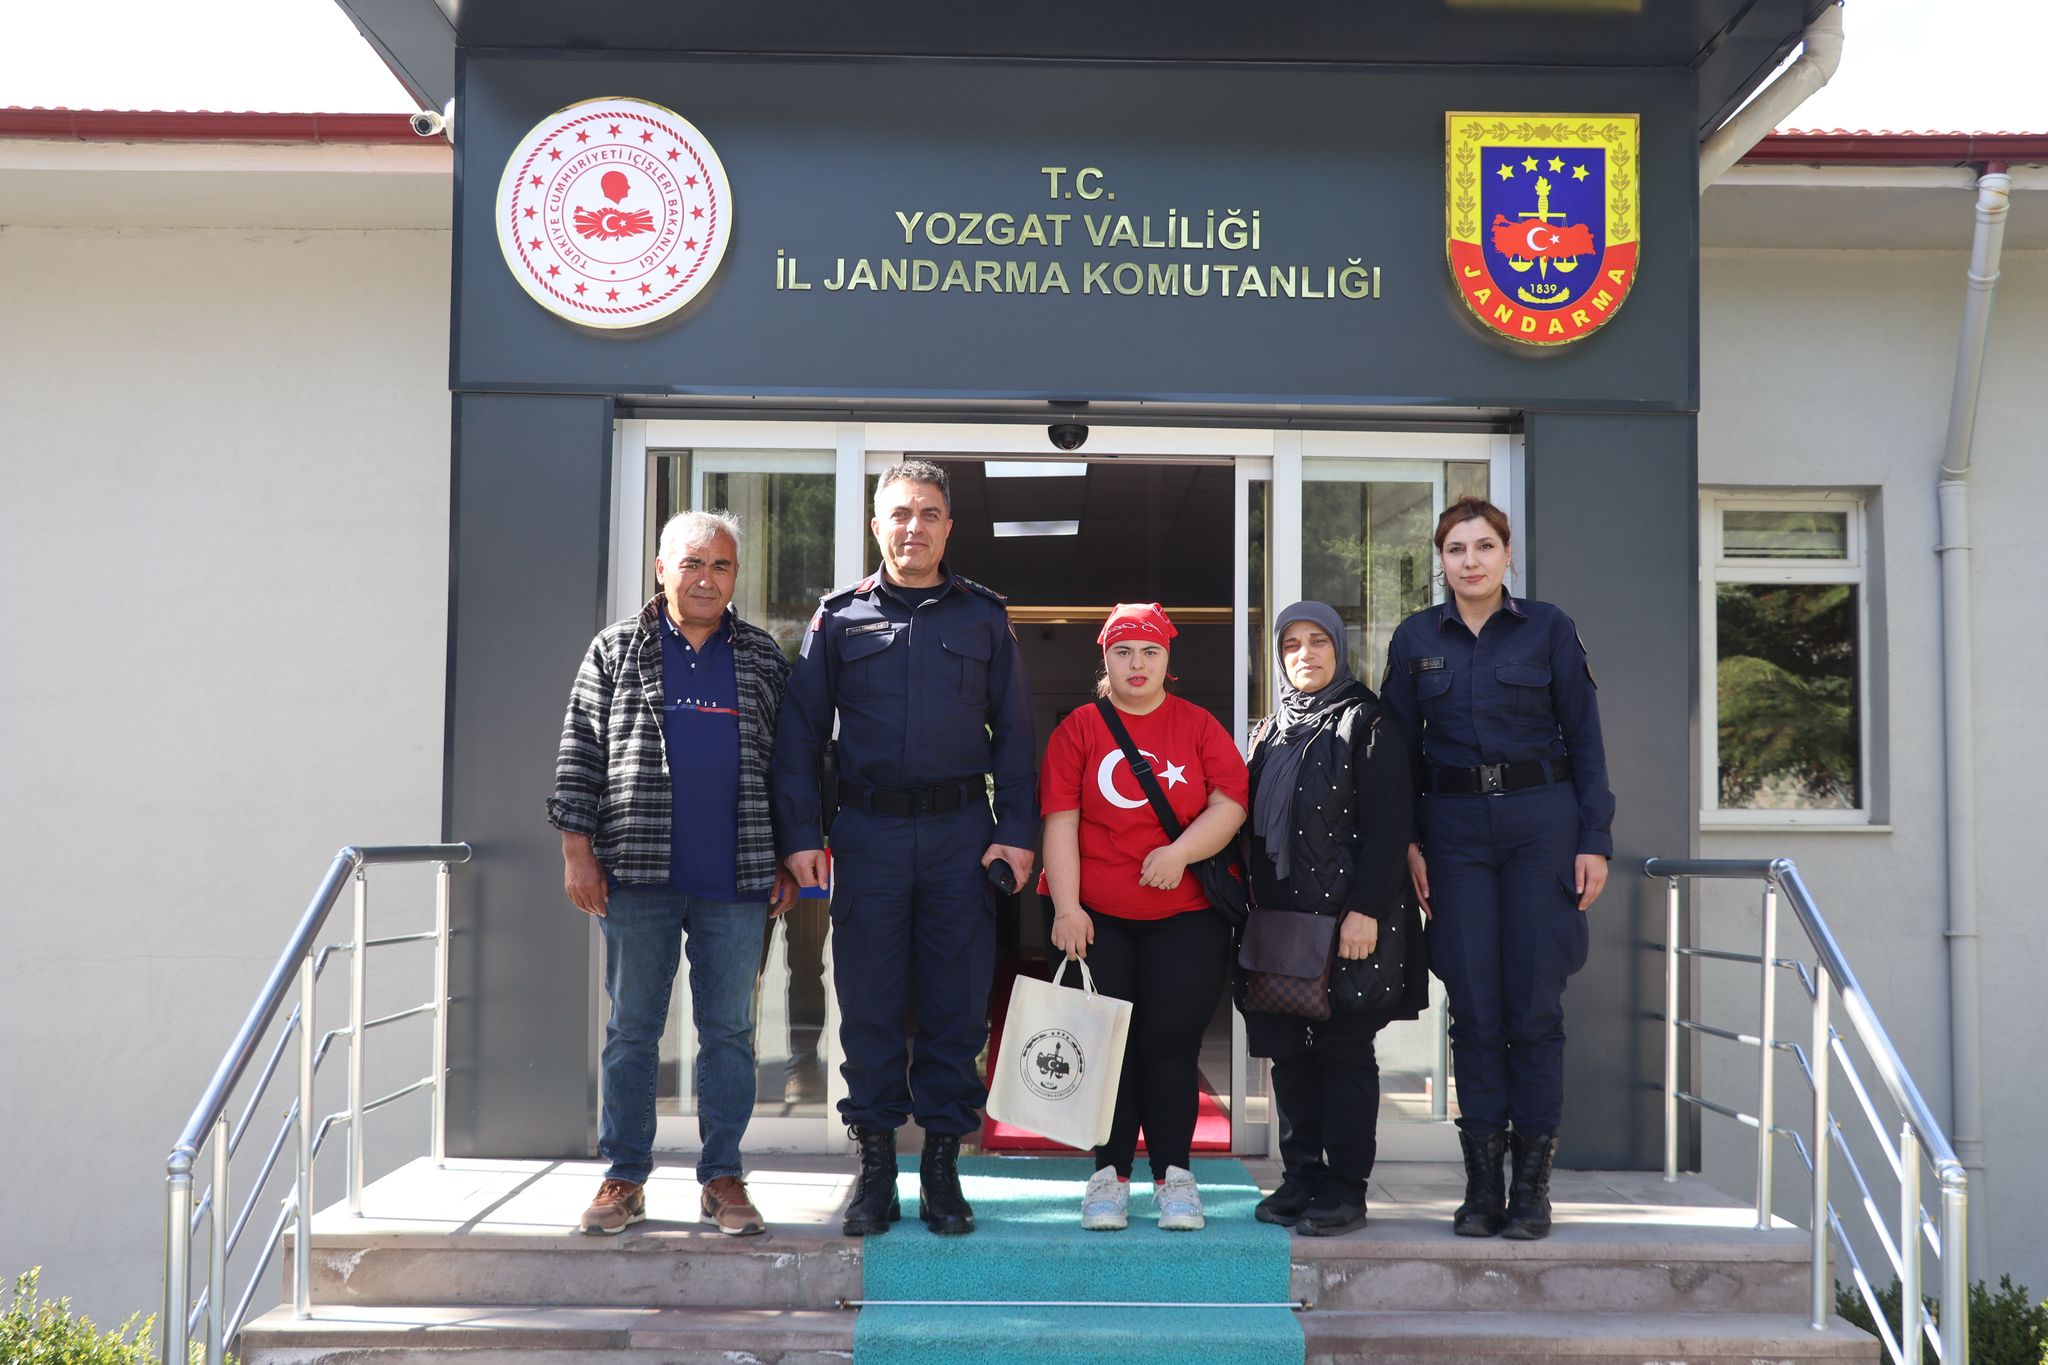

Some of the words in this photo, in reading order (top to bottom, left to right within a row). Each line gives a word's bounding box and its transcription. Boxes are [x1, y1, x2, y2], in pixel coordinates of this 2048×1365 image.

[549, 148, 624, 213] CUMHURİYETİ
[627, 149, 678, 195] İÇİŞLERİ
[1041, 166, 1116, 201] T.C.
[550, 216, 588, 270] TÜRKİYE
[639, 199, 678, 270] BAKANLIĞI
[896, 211, 1072, 247] YOZGAT
[1083, 207, 1261, 250] VALİLİĞİ
[776, 249, 812, 291] İL
[824, 257, 1069, 295] JANDARMA
[1083, 256, 1382, 300] KOMUTANLIĞI
[1530, 283, 1557, 294] 1839
[1464, 264, 1626, 335] JANDARMA
[676, 697, 717, 708] PARIS
